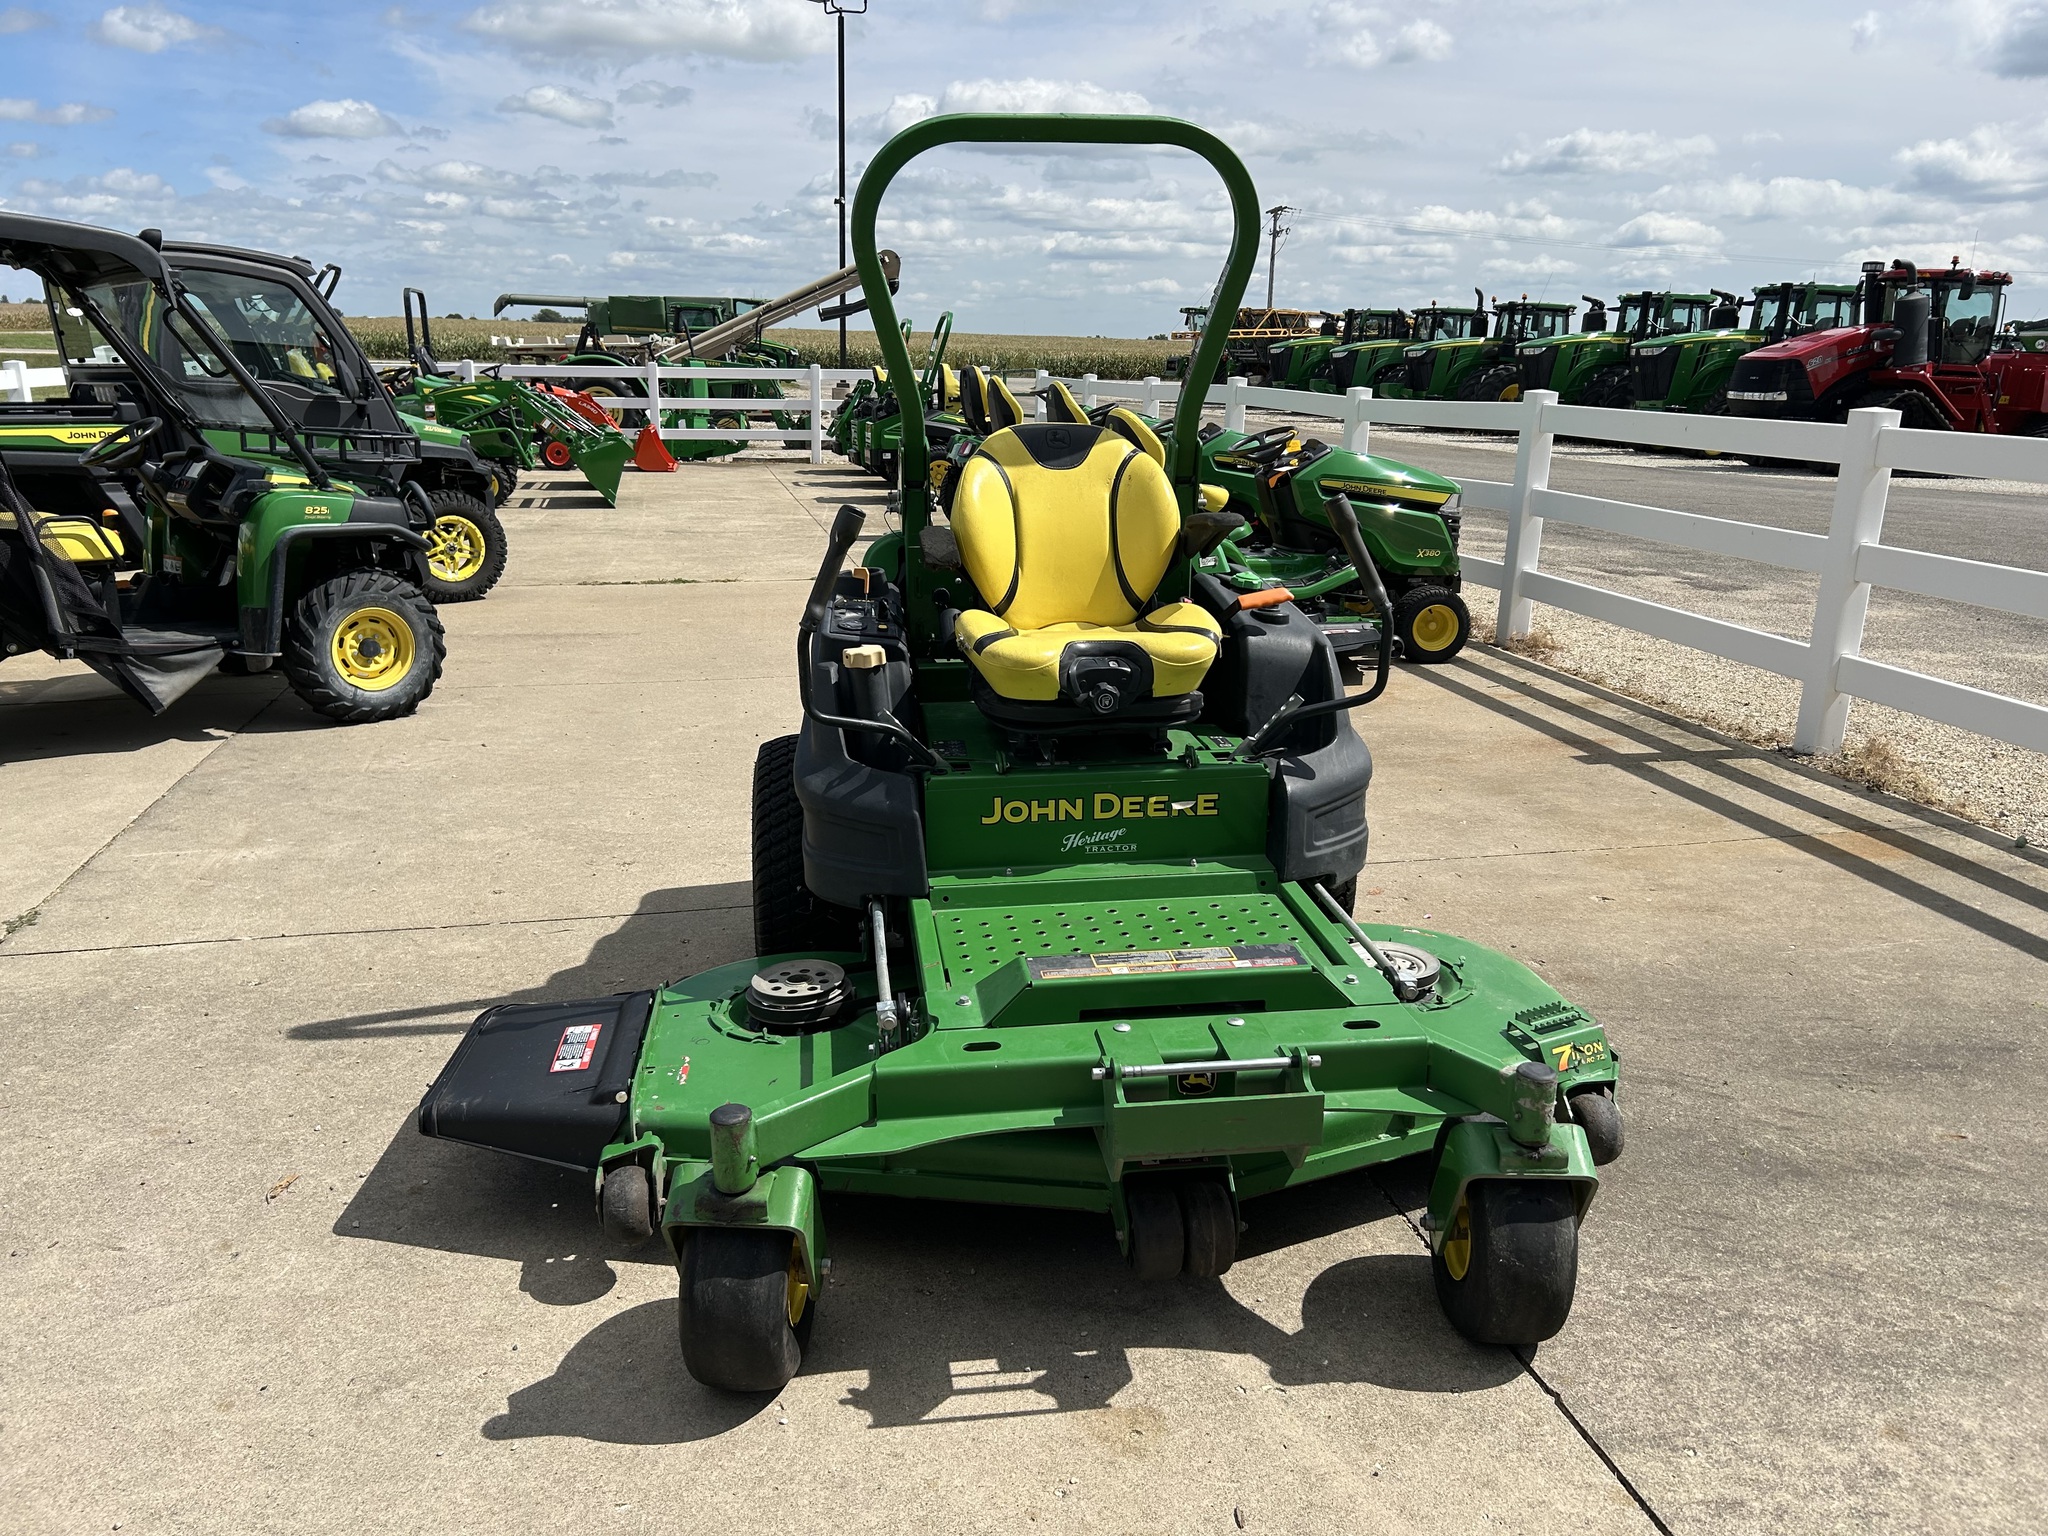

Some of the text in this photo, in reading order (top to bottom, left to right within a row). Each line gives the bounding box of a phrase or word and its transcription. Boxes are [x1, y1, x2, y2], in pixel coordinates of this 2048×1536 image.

[67, 431, 97, 439] JOHN
[1341, 482, 1387, 495] JOHN DEERE
[981, 797, 1084, 824] JOHN
[1060, 828, 1127, 852] Heritage
[1085, 844, 1137, 852] TRACTOR
